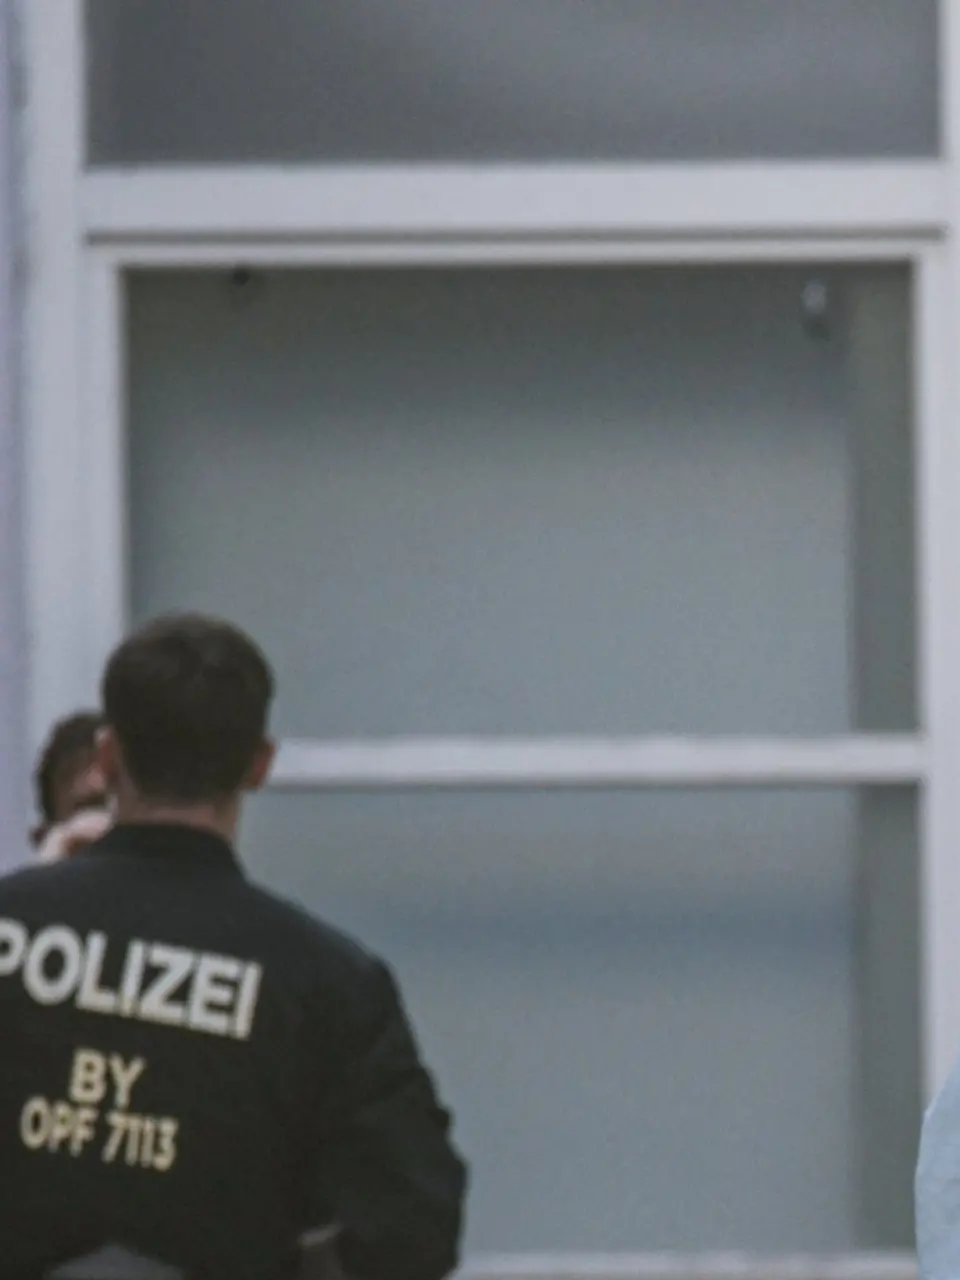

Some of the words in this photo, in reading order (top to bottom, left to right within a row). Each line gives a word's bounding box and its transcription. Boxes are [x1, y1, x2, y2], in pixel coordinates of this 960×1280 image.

[70, 1047, 147, 1109] BY
[20, 1096, 98, 1158] OPF
[102, 1110, 179, 1172] 7113
